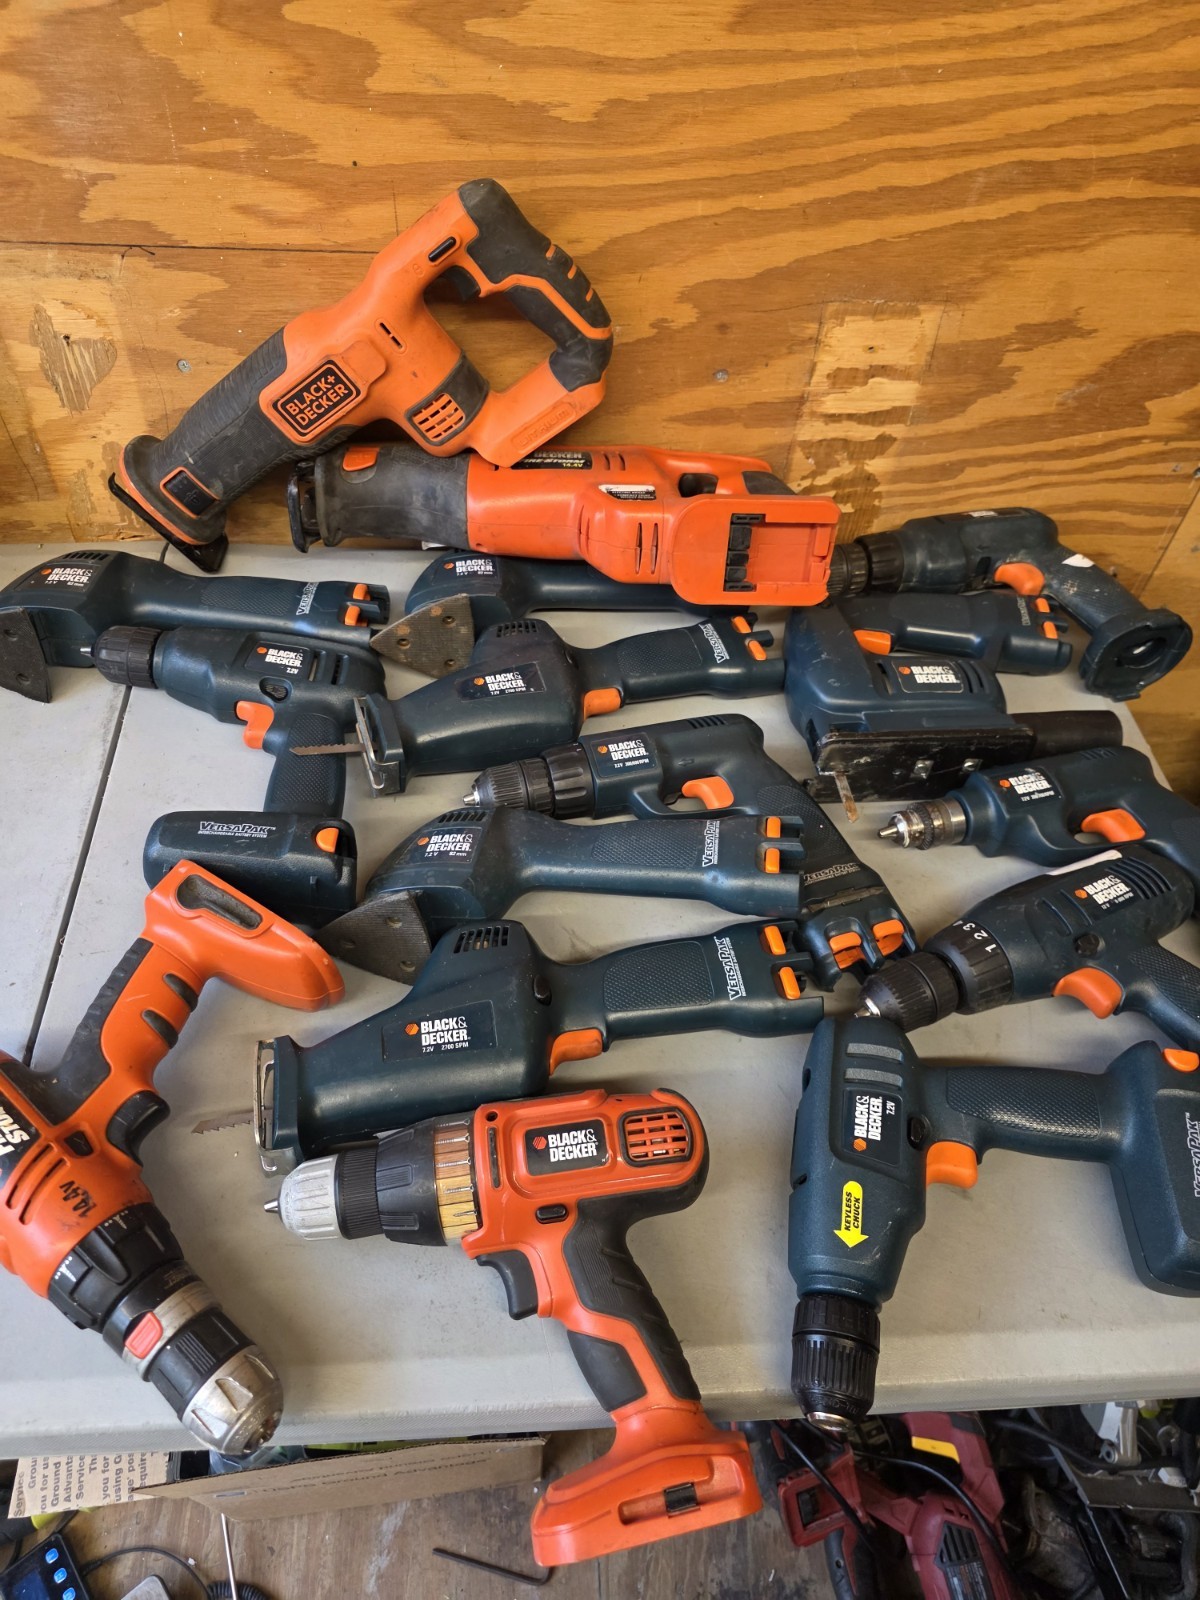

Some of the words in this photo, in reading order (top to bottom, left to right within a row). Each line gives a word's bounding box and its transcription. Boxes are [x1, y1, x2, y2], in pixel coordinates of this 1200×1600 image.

[296, 384, 349, 426] DECKER
[456, 565, 494, 573] DECKER
[47, 574, 89, 583] DECKER
[265, 654, 302, 668] DECKER
[487, 680, 525, 691] DECKER
[914, 674, 960, 683] DECKER
[611, 747, 649, 760] DECKER
[1014, 779, 1052, 794] DECKER
[426, 842, 471, 852] DECKER
[1092, 882, 1130, 905] DECKER
[962, 922, 976, 931] 3
[973, 929, 988, 940] 2
[985, 943, 997, 953] 1
[421, 1029, 469, 1046] DECKER
[455, 1041, 469, 1049] SPM
[886, 1100, 896, 1115] 7.2V
[868, 1097, 882, 1141] DECKER
[549, 1142, 598, 1162] DECKER
[844, 1191, 853, 1231] KEYLESS
[852, 1196, 861, 1229] CHUCK
[101, 1456, 109, 1474] for
[40, 1474, 48, 1491] for
[50, 1461, 61, 1507] Ground
[75, 1455, 85, 1500] Service
[113, 1468, 123, 1502] using
[13, 1470, 26, 1518] Service
[102, 1476, 110, 1500] you
